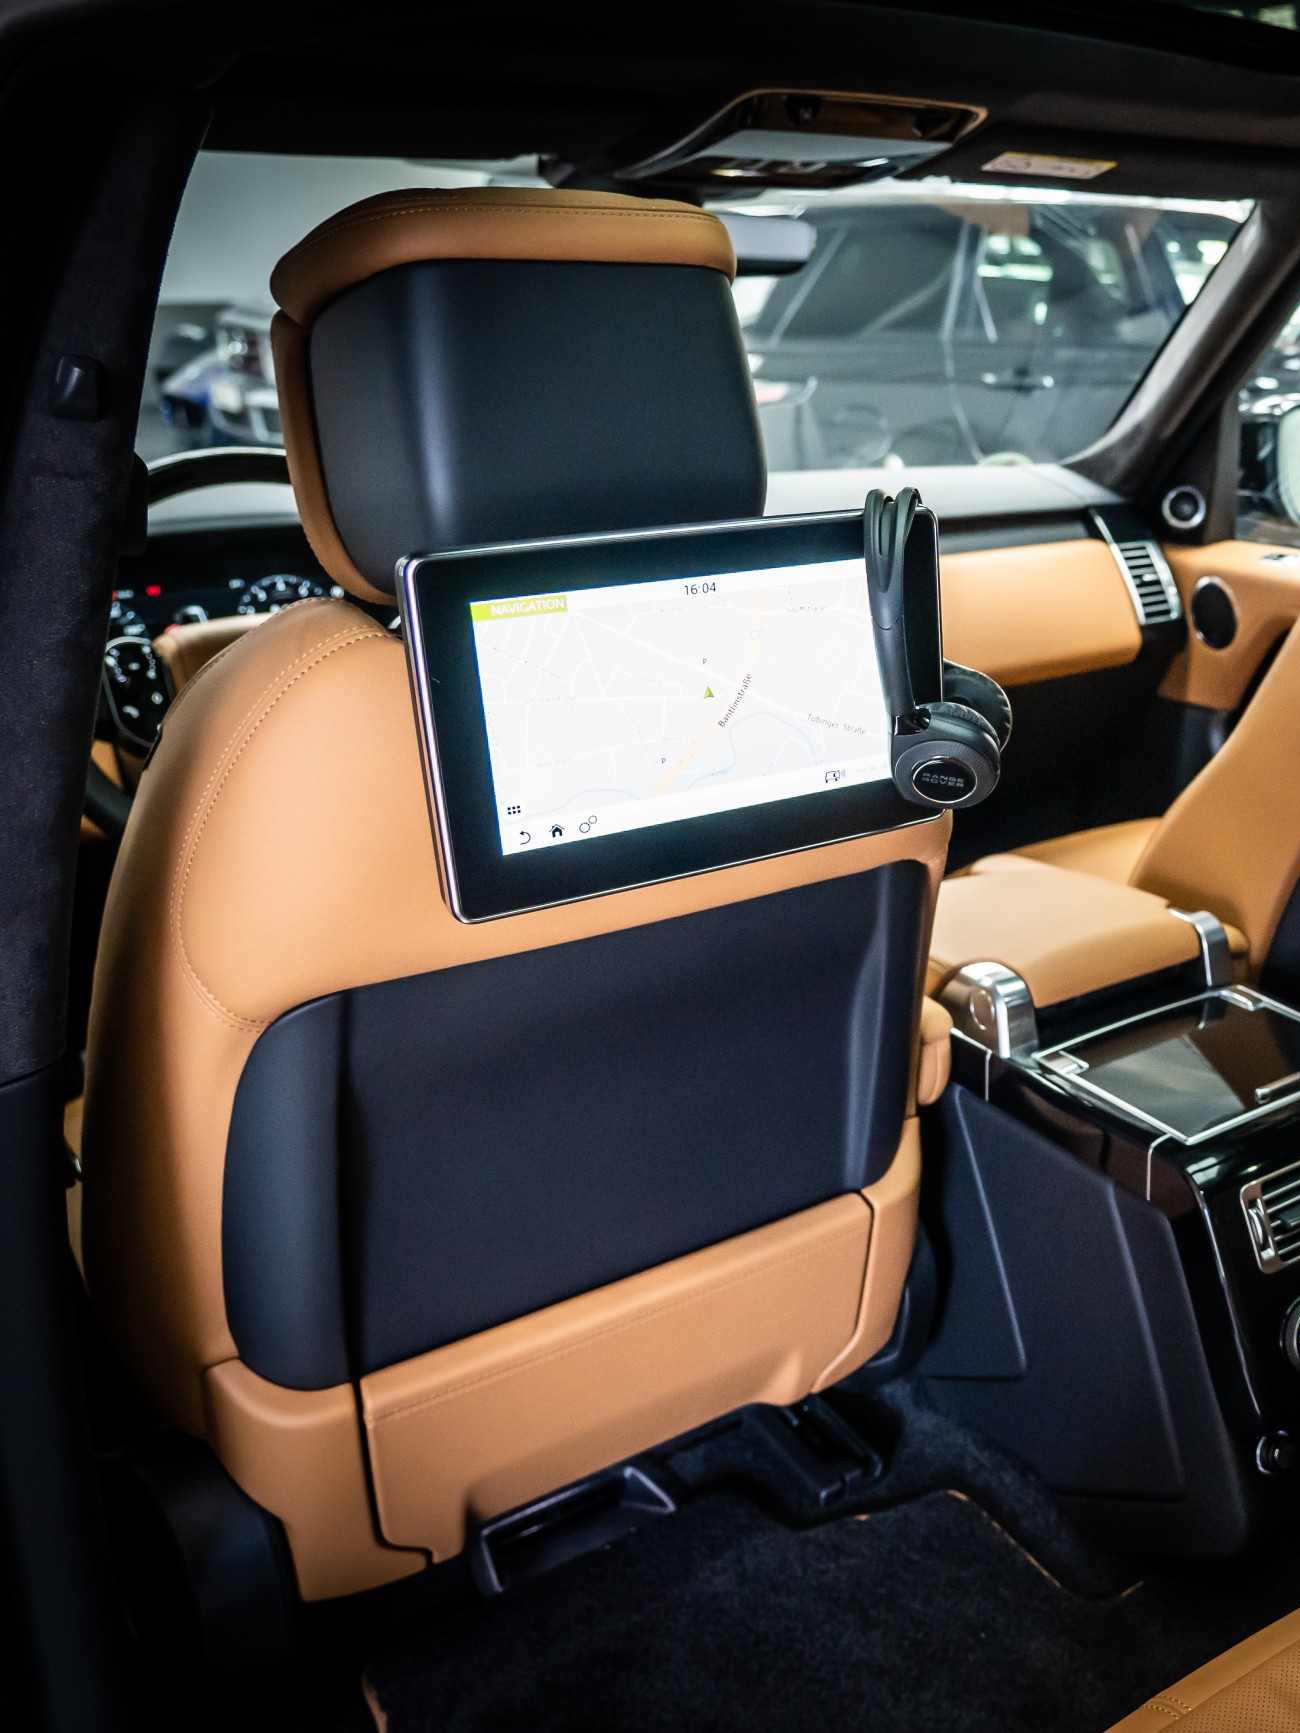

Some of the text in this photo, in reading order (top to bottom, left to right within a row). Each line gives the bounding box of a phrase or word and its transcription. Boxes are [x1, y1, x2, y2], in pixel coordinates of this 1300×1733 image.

[684, 581, 717, 596] 16:04
[491, 598, 565, 617] NAVIGATION
[717, 673, 752, 728] Bantlinstraße
[921, 777, 964, 788] ROVER
[922, 772, 964, 783] RANGE
